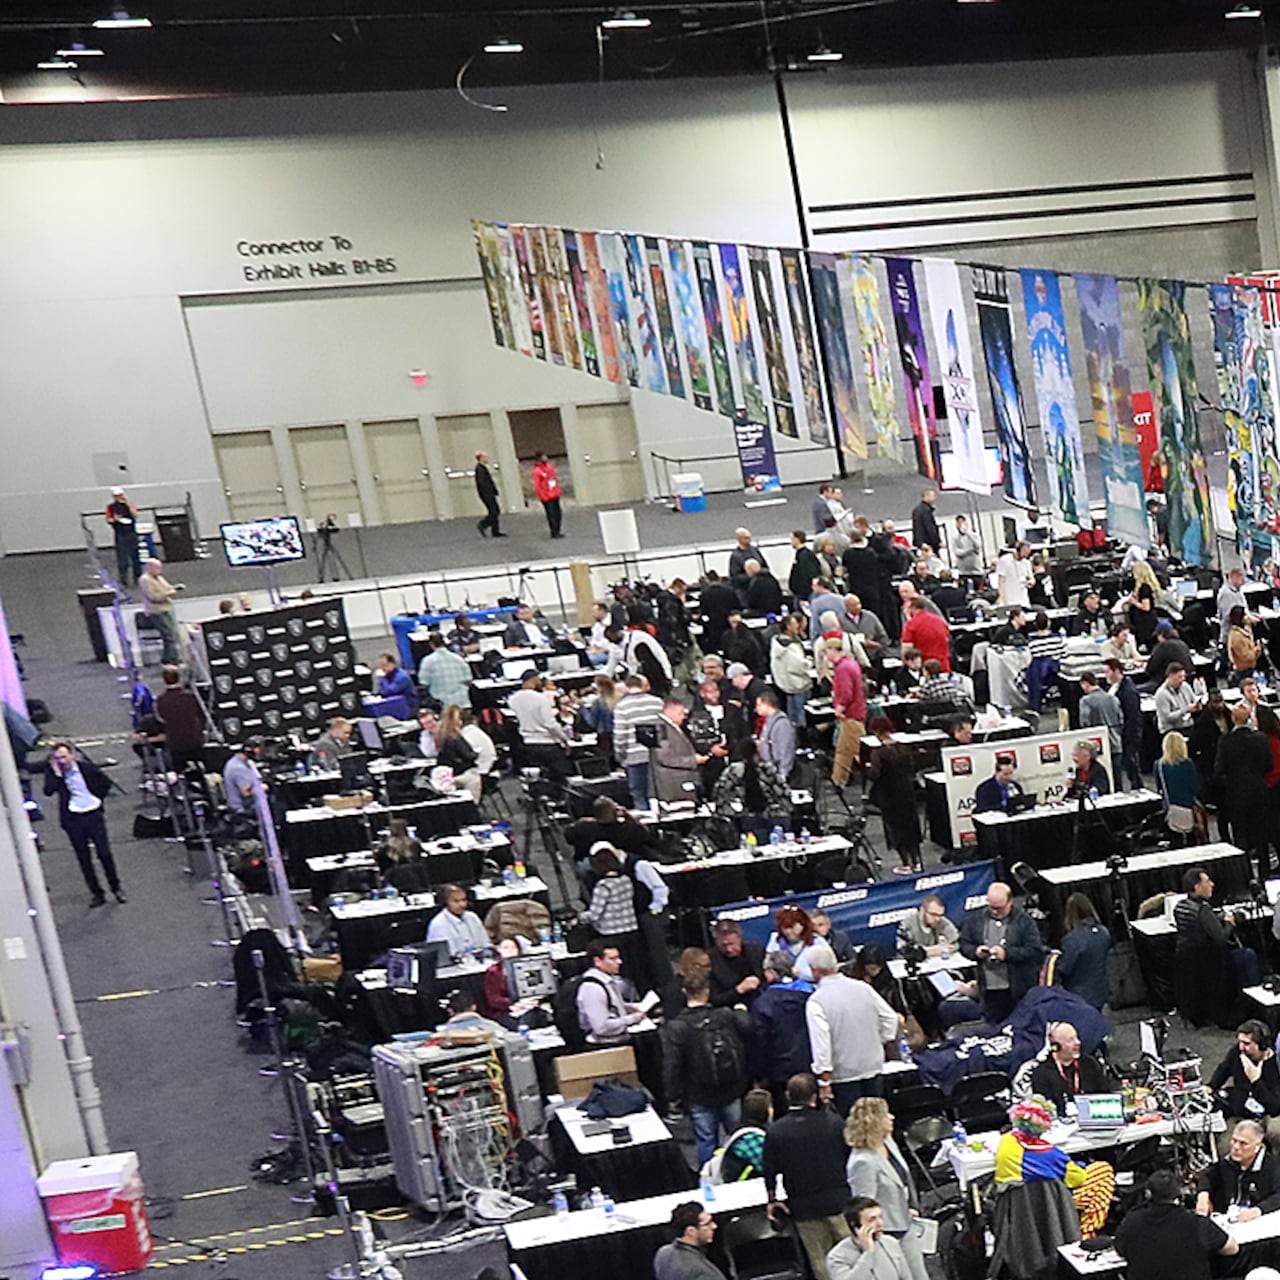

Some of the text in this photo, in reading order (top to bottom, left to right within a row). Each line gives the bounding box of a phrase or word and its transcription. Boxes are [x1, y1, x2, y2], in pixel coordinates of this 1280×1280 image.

[237, 235, 353, 257] Connector To
[243, 264, 303, 281] Exhibit
[309, 261, 346, 276] Halls
